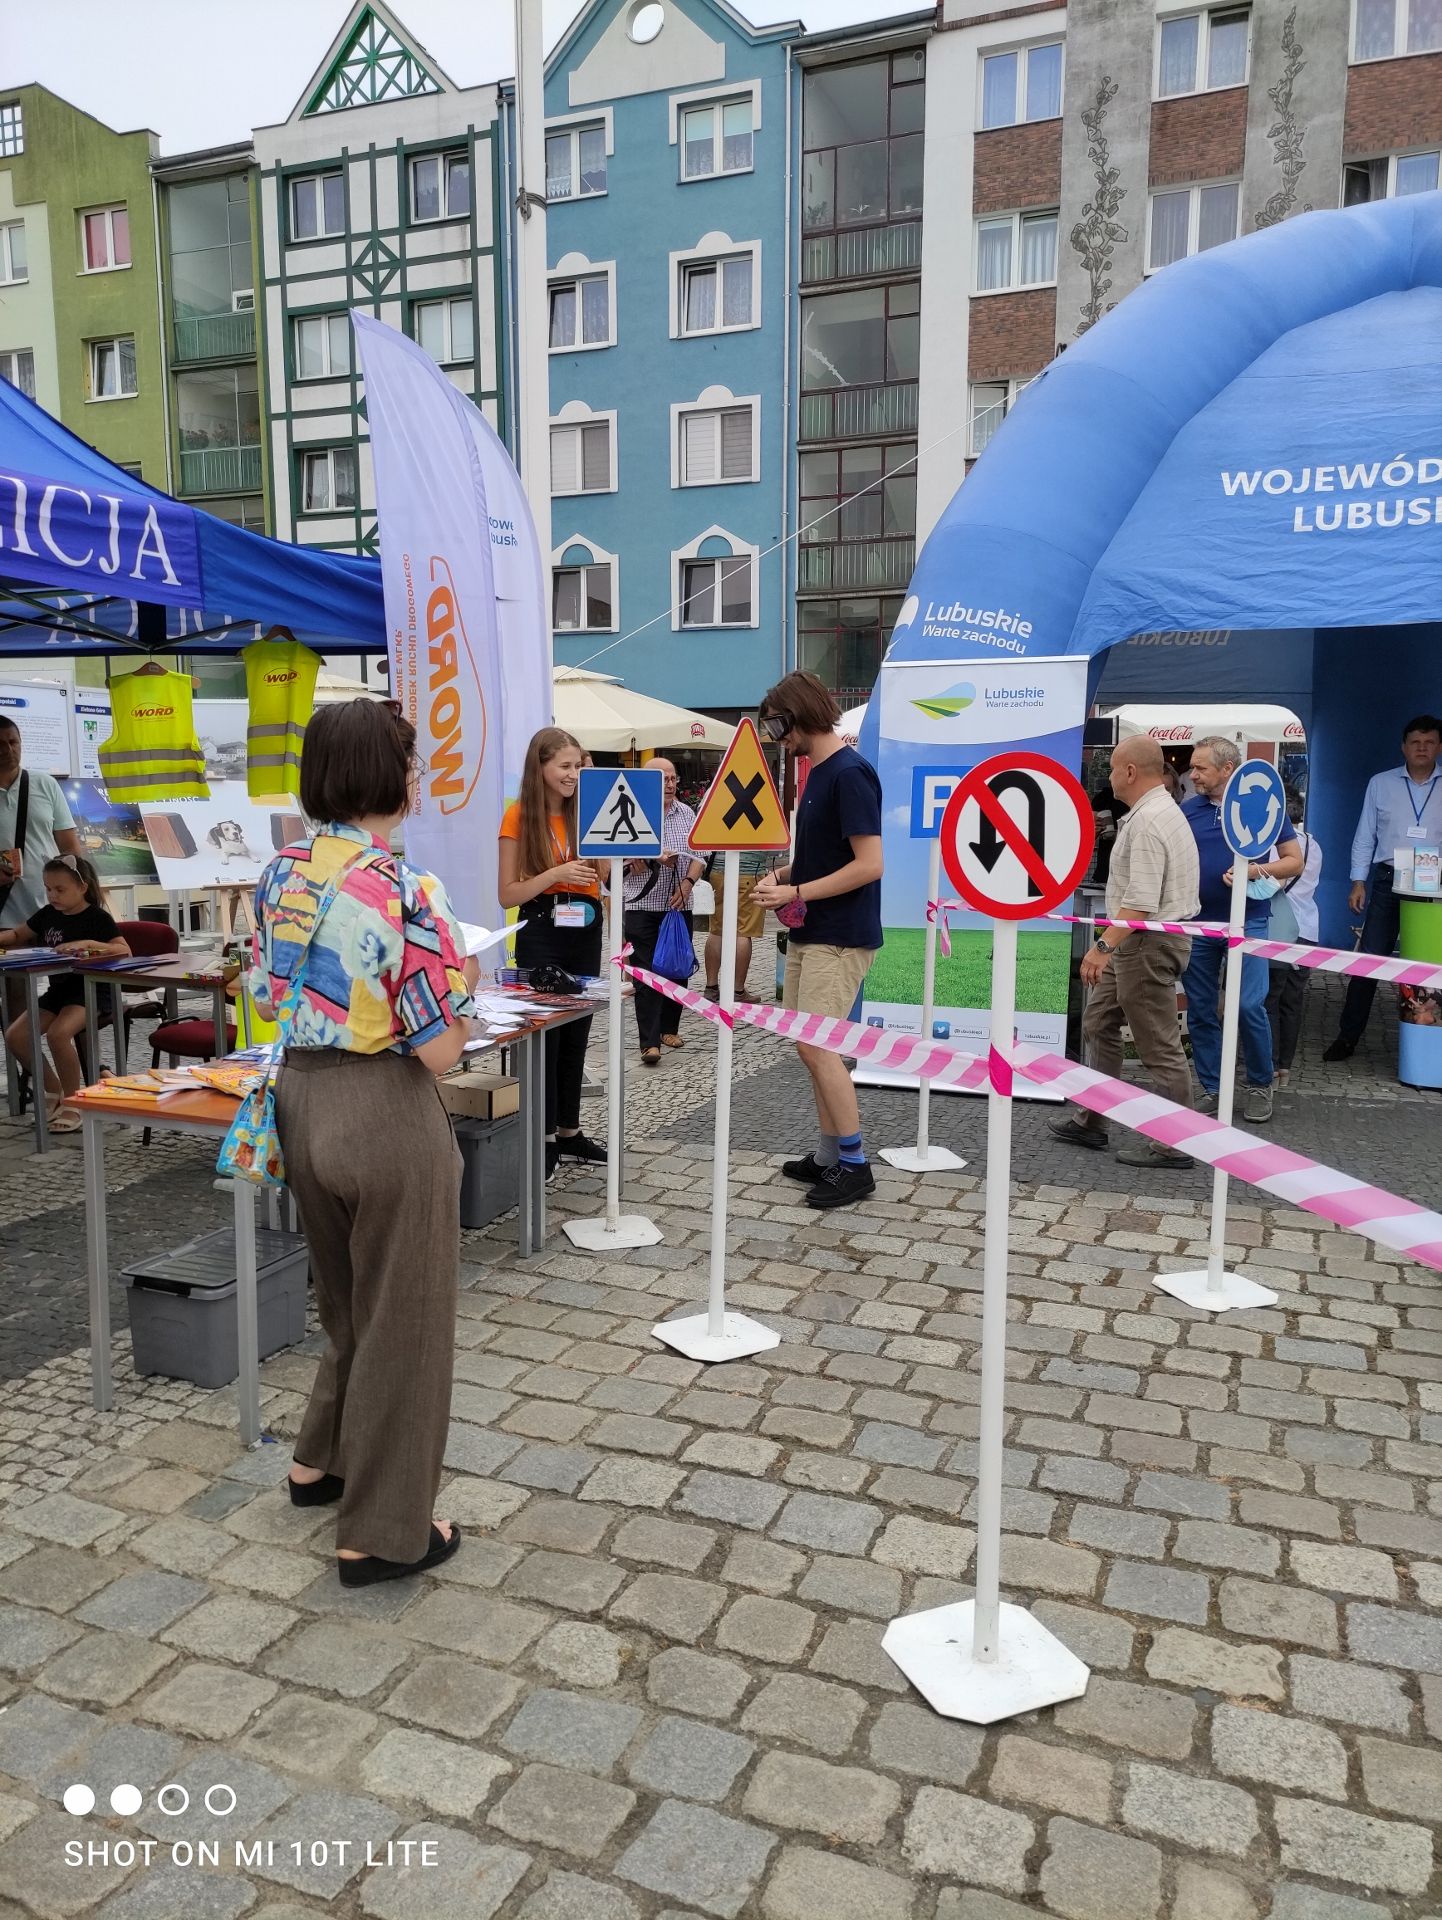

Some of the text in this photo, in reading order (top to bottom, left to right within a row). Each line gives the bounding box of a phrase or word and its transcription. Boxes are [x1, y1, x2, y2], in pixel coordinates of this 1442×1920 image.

[0, 475, 182, 586] ICJA
[924, 602, 1033, 639] Lubuskie
[922, 624, 1027, 655] Warte zachodu
[984, 687, 1045, 699] Lubuskie
[1010, 700, 1044, 708] zachodu
[133, 706, 174, 718] WORD
[923, 775, 961, 829] P
